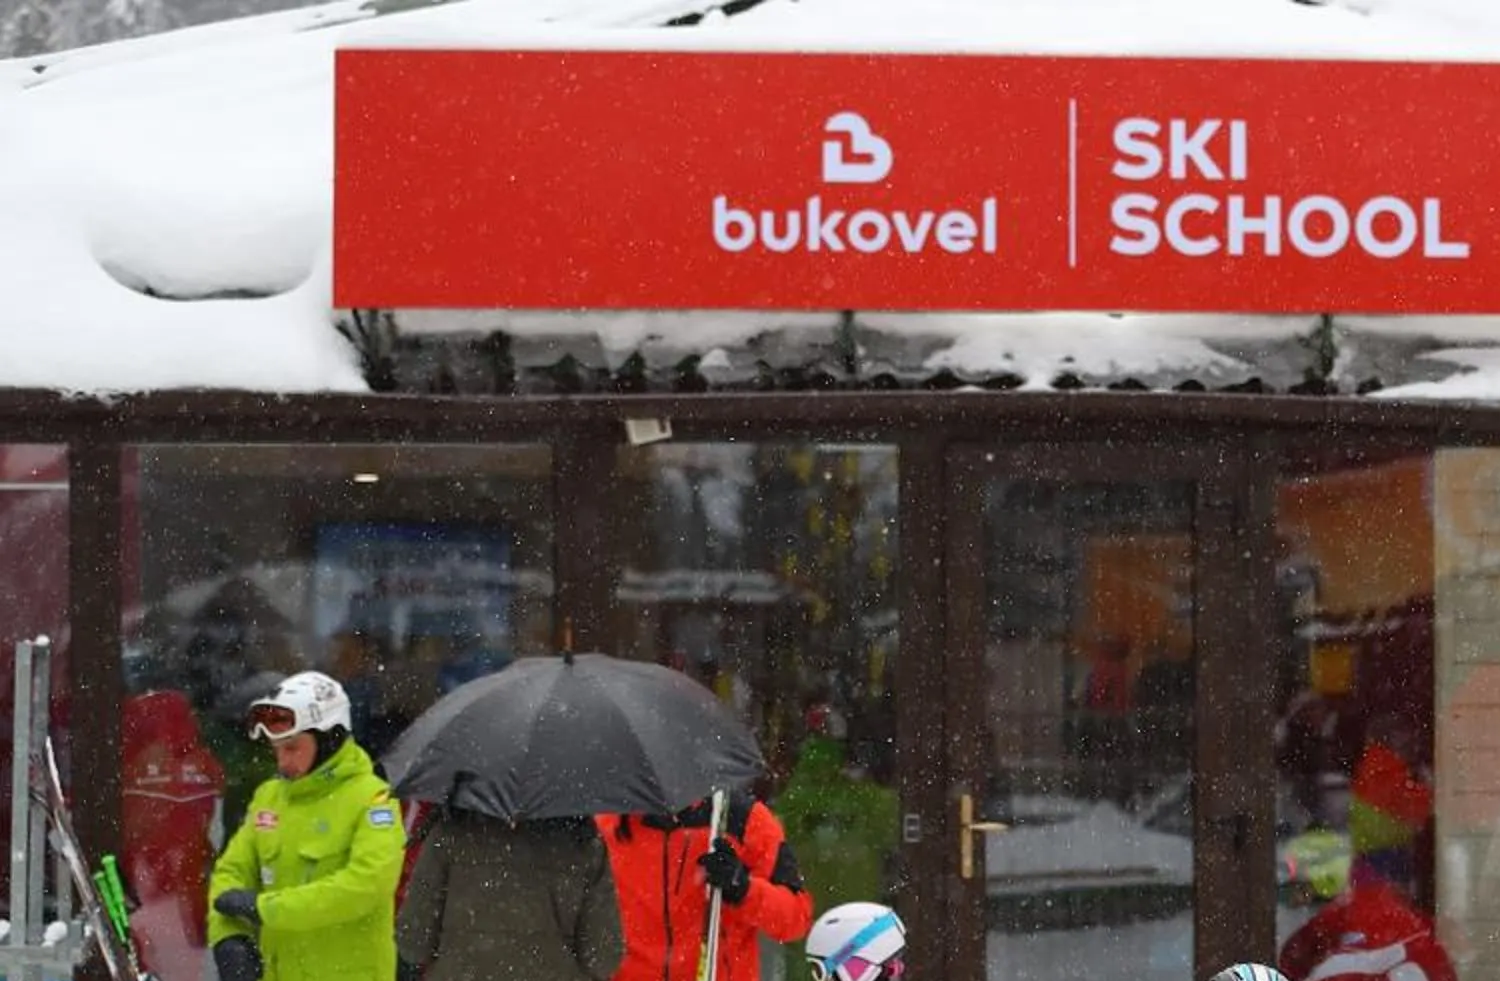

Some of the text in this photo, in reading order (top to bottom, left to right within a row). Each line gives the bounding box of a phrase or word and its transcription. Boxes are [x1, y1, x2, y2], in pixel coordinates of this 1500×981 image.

[1111, 117, 1247, 181] SKI
[713, 195, 997, 253] bukovel
[1109, 193, 1470, 258] SCHOOL
